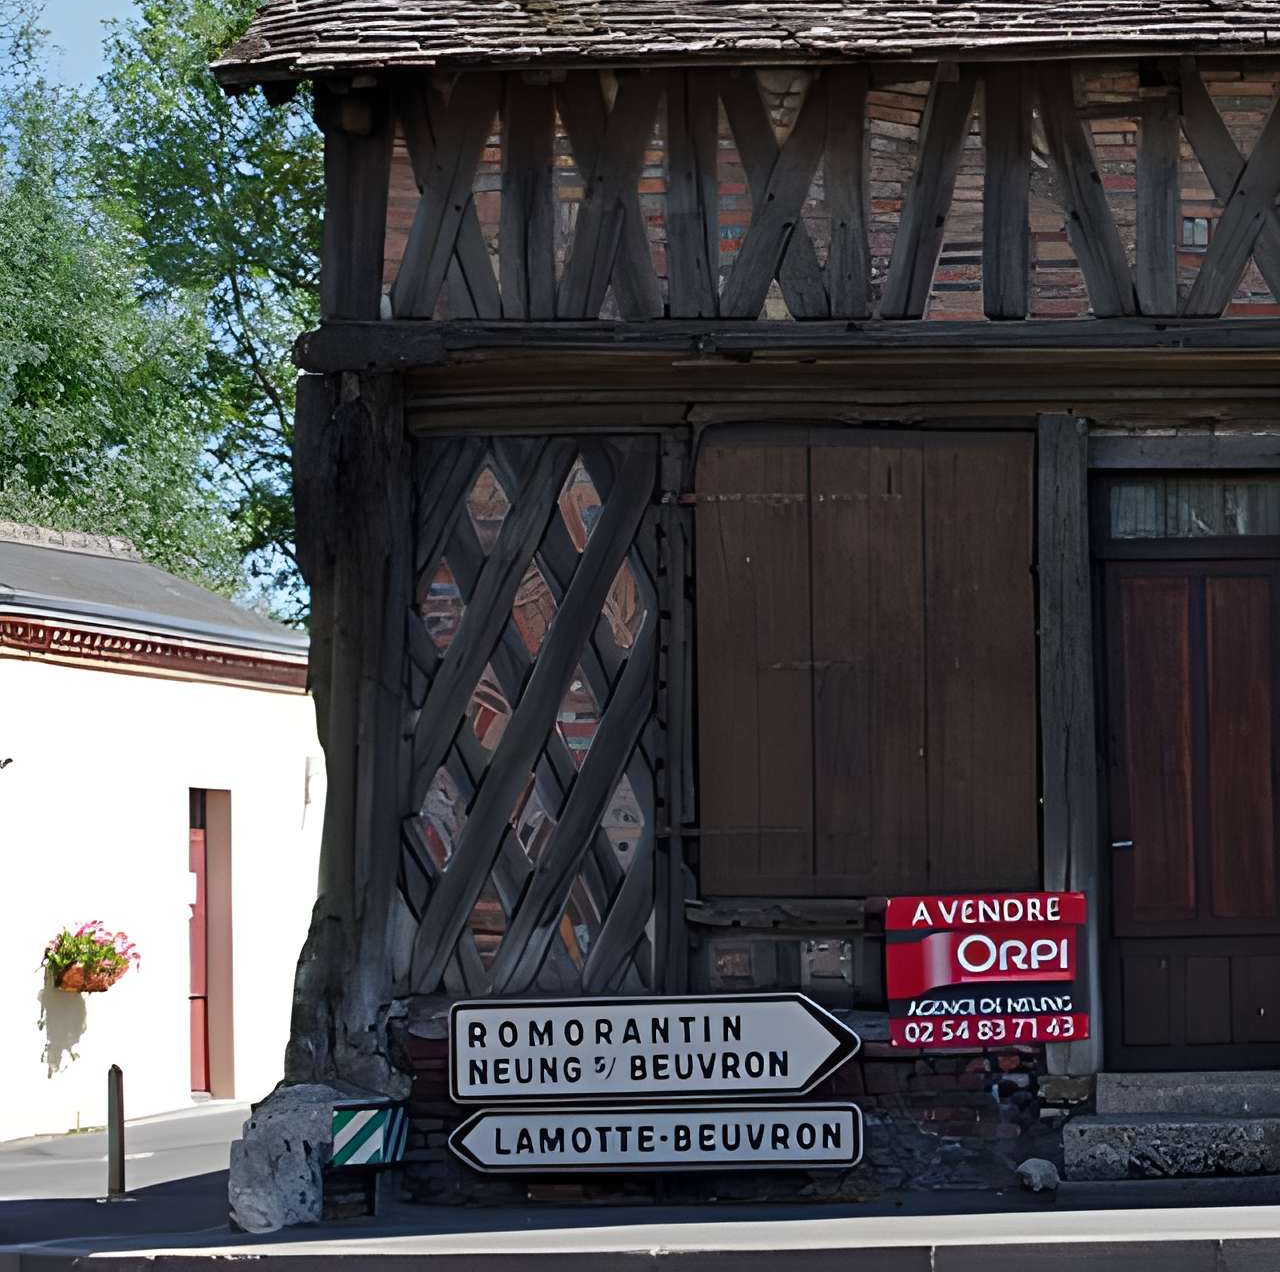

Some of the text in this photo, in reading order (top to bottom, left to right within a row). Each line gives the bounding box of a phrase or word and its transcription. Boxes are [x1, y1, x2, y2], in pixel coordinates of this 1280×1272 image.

[912, 897, 1061, 927] A VENDRE
[468, 1015, 742, 1048] ROMORANTIN
[905, 1022, 934, 1043] 02
[468, 1056, 582, 1086] NEUNG
[630, 1050, 789, 1081] BEUVRON
[495, 1122, 842, 1156] LAMOTTE-BEUVRON
